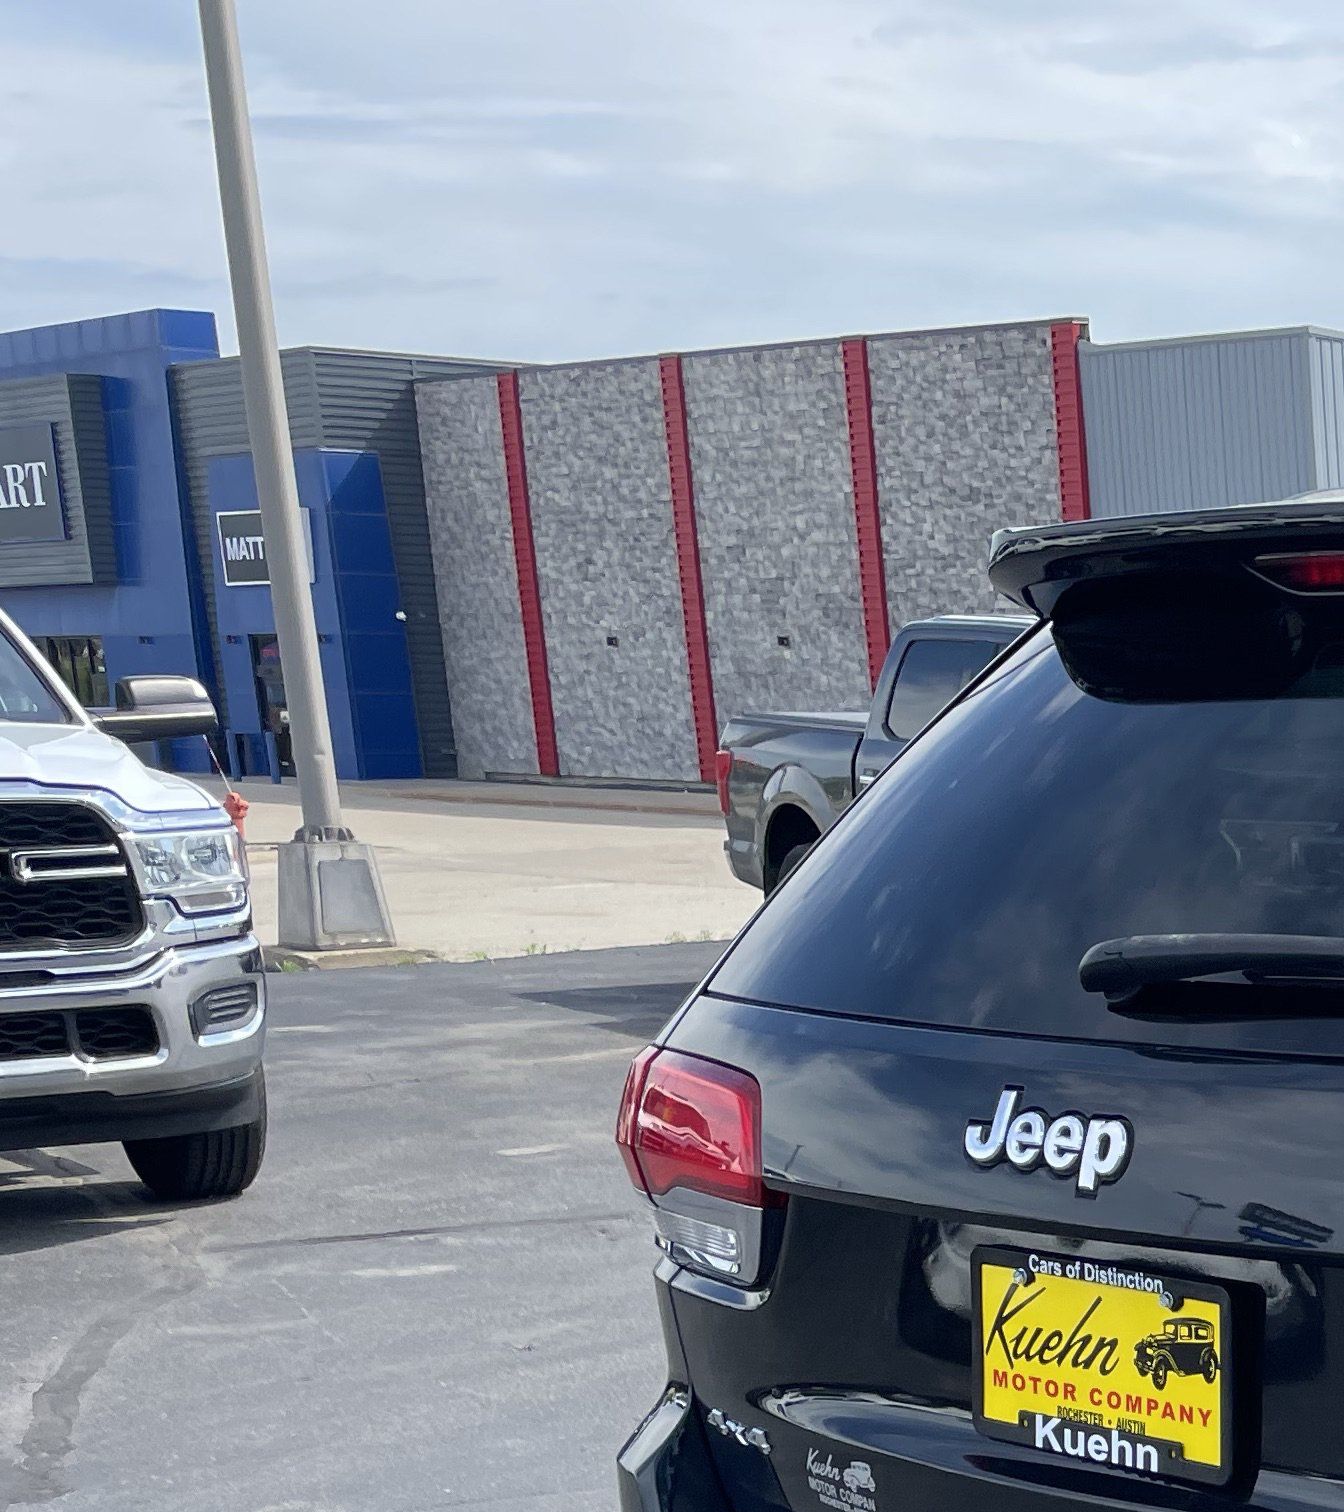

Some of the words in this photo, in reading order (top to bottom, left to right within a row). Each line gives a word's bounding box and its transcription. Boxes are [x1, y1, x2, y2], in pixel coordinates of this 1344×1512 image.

[225, 536, 264, 561] MATT
[965, 1089, 1128, 1191] Jeep
[1028, 1254, 1062, 1276] Cars
[1065, 1261, 1081, 1280] of
[1083, 1262, 1164, 1295] Distinction
[985, 1284, 1120, 1376] Kuehn
[993, 1369, 1077, 1402] MOTOR
[1089, 1387, 1212, 1428] COMPANY
[1056, 1405, 1104, 1427] ROCHESTER
[1116, 1416, 1146, 1436] AUSTIN
[1034, 1413, 1159, 1473] Kuehn
